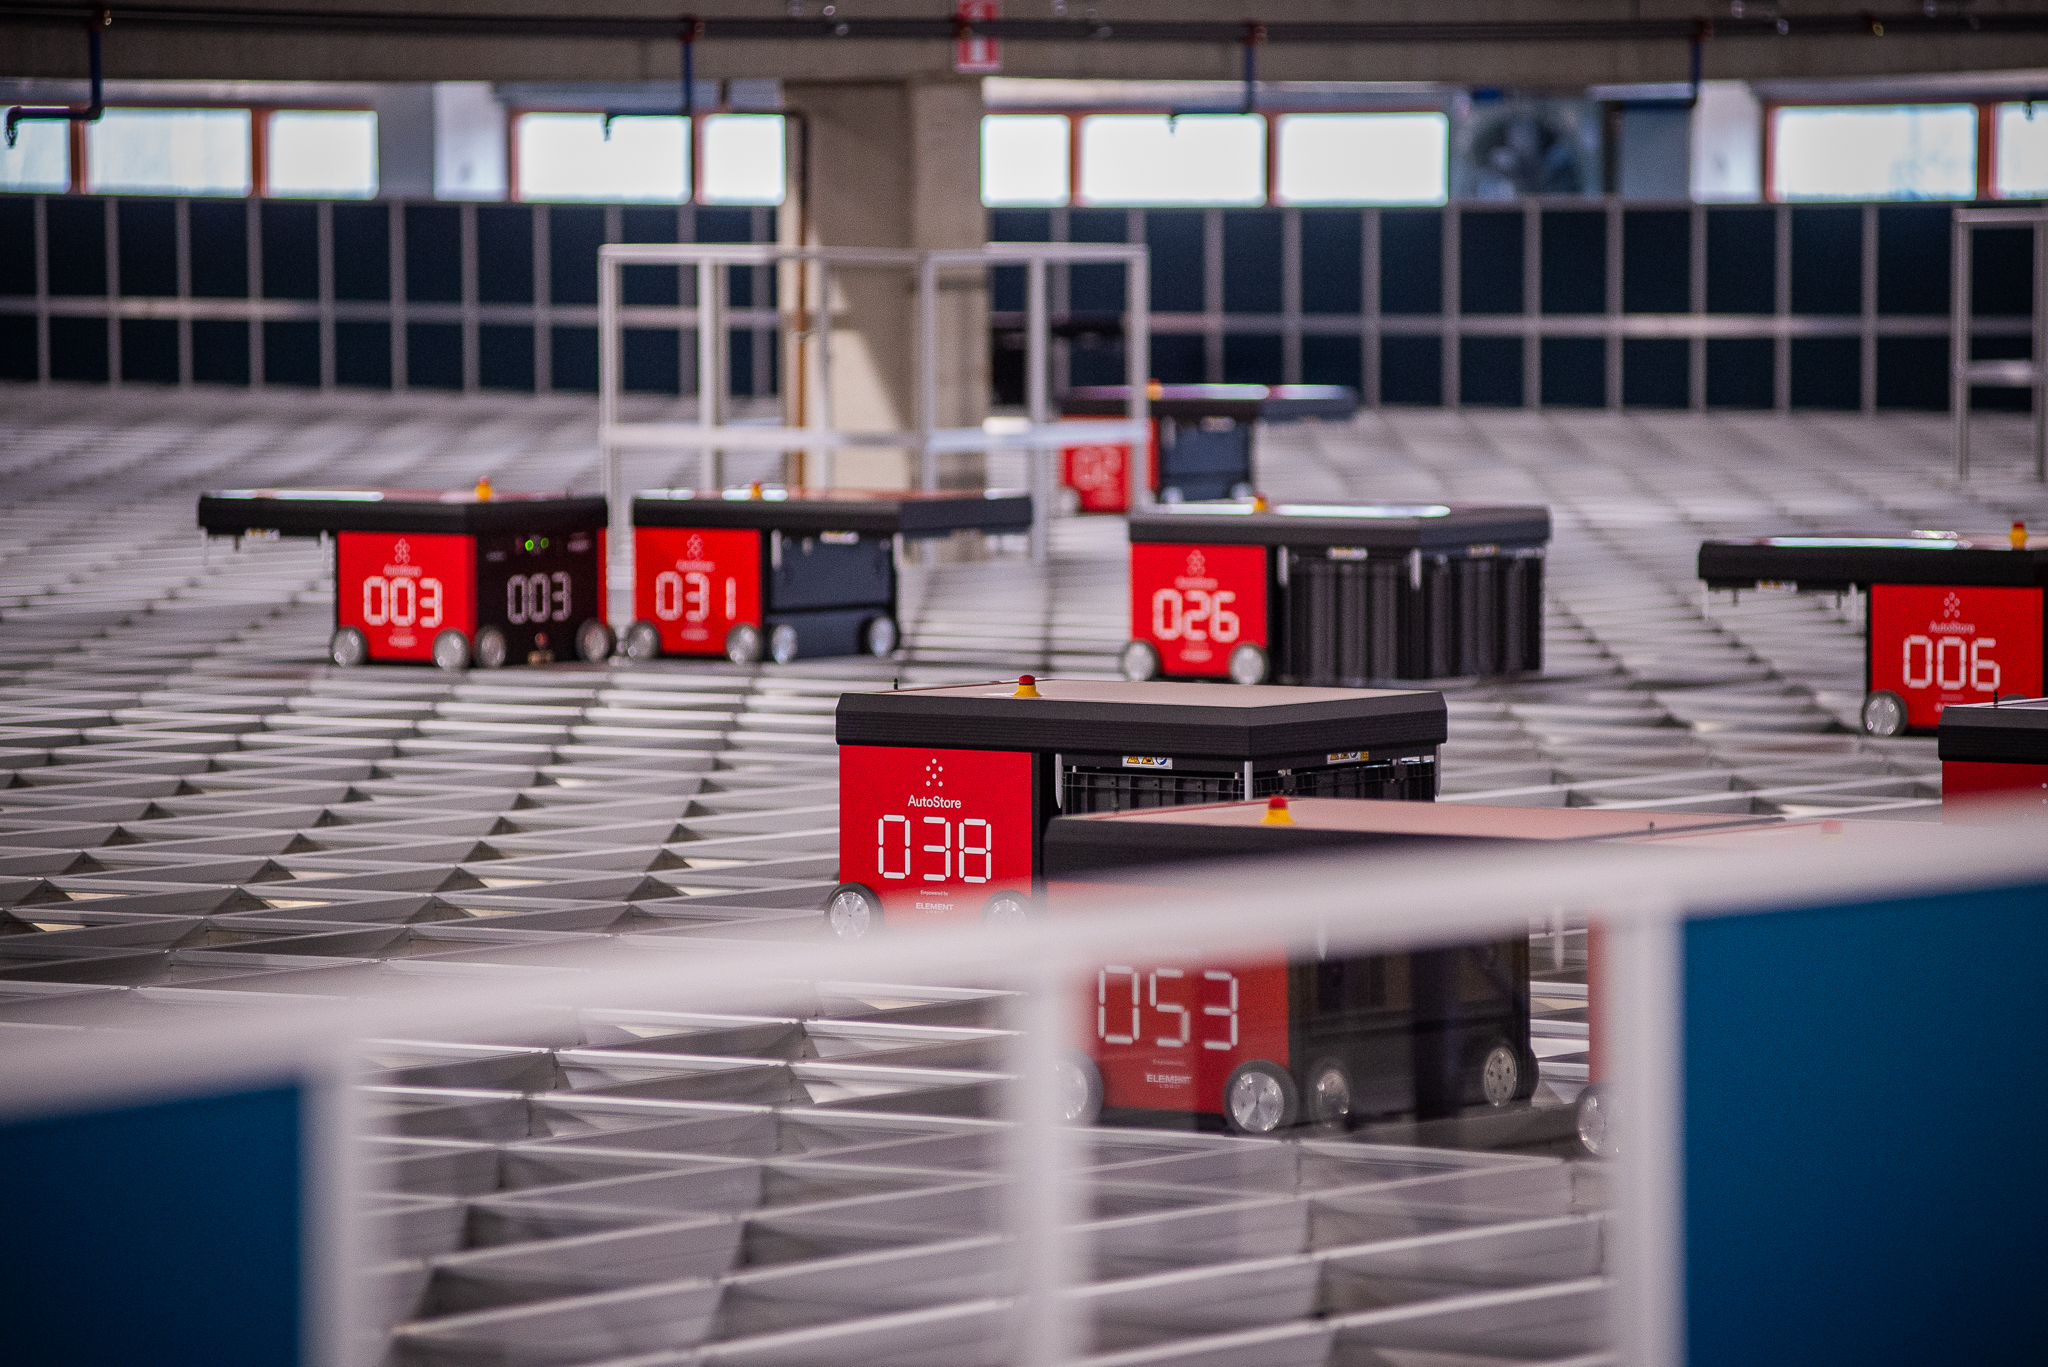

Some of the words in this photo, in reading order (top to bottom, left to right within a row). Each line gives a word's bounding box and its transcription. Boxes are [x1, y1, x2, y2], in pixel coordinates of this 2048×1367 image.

[363, 576, 443, 628] 003
[507, 571, 572, 624] 003
[655, 571, 737, 622] 031
[1152, 588, 1240, 643] 026
[1903, 635, 2000, 692] 006
[907, 794, 961, 809] AutoStore
[878, 814, 992, 884] 038
[915, 902, 954, 911] ELEMENT
[1098, 965, 1238, 1050] 053
